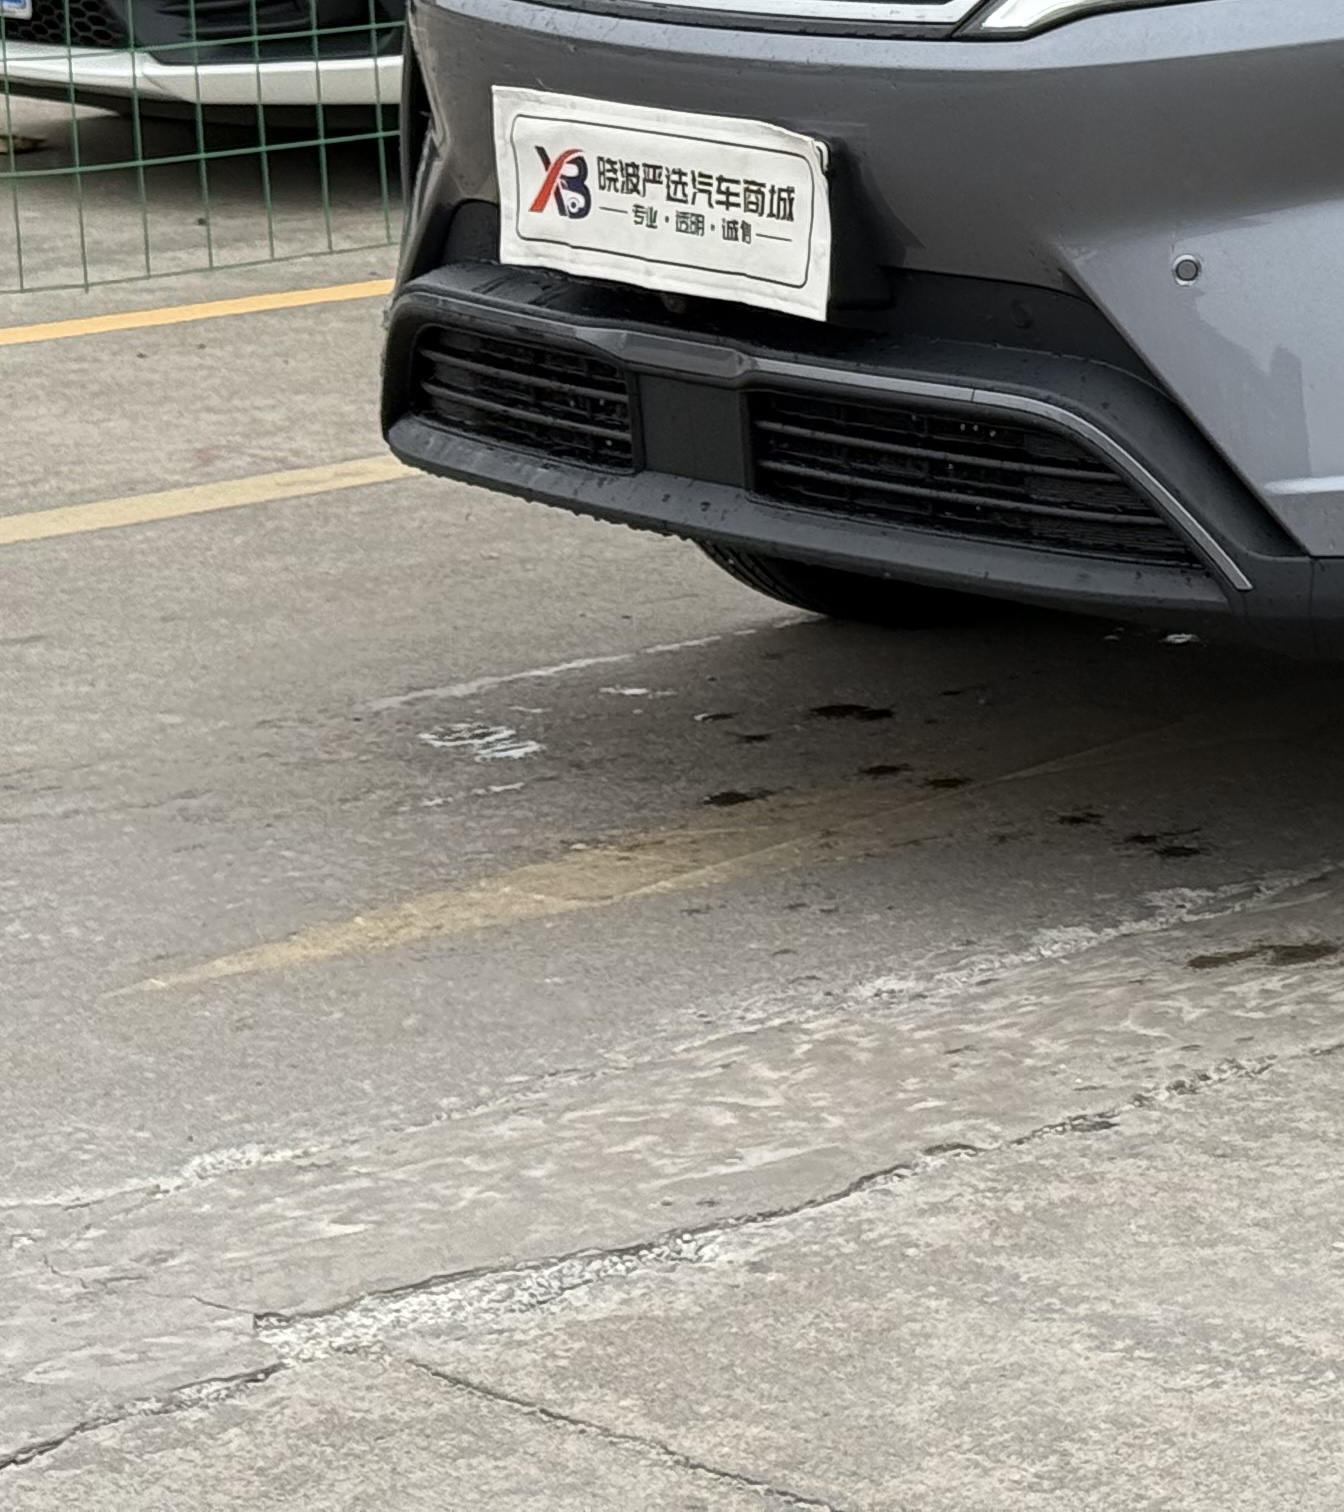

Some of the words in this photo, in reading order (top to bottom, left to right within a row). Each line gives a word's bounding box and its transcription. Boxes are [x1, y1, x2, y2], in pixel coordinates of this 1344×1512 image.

[596, 155, 796, 222] 晓波严选汽车商城
